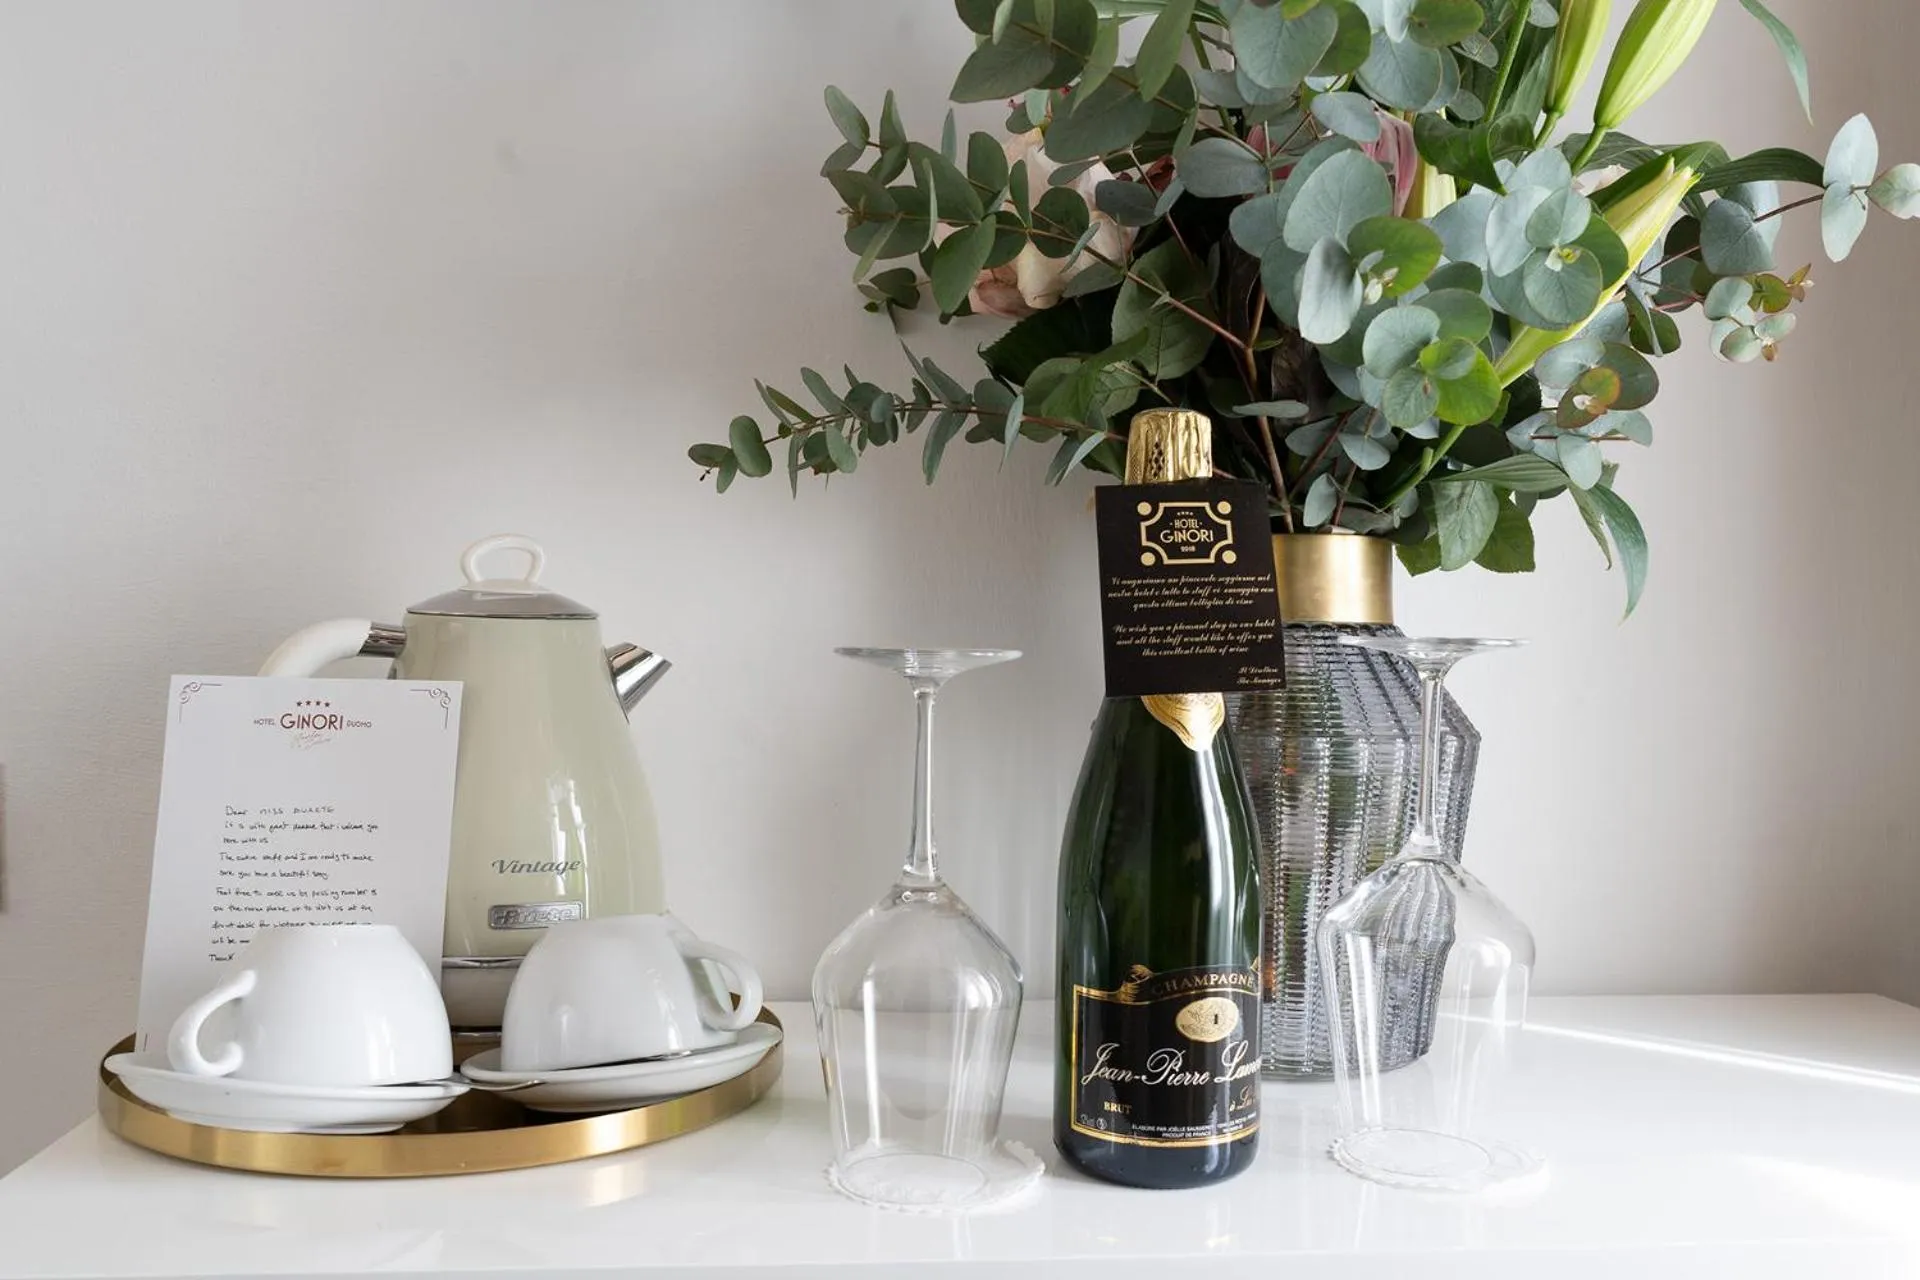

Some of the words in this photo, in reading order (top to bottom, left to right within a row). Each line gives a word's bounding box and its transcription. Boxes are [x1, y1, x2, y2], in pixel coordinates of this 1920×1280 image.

[1174, 518, 1200, 529] HOTEL
[1160, 529, 1214, 544] GINORI
[1134, 587, 1155, 596] hotel
[1191, 585, 1212, 597] staff
[1148, 625, 1165, 635] you
[1210, 621, 1227, 632] stay
[1254, 619, 1276, 628] hotel
[1162, 634, 1183, 646] staff
[1236, 631, 1256, 644] offer
[1256, 634, 1274, 643] you
[1194, 645, 1218, 654] bottle
[1218, 644, 1229, 656] of
[254, 718, 275, 726] HOTEL
[280, 713, 344, 730] GINORI
[491, 859, 582, 876] Vintage
[1152, 973, 1256, 996] CHAMPAGNE
[1081, 1042, 1210, 1086] Jean-Pierre
[1103, 1101, 1133, 1114] BRUT
